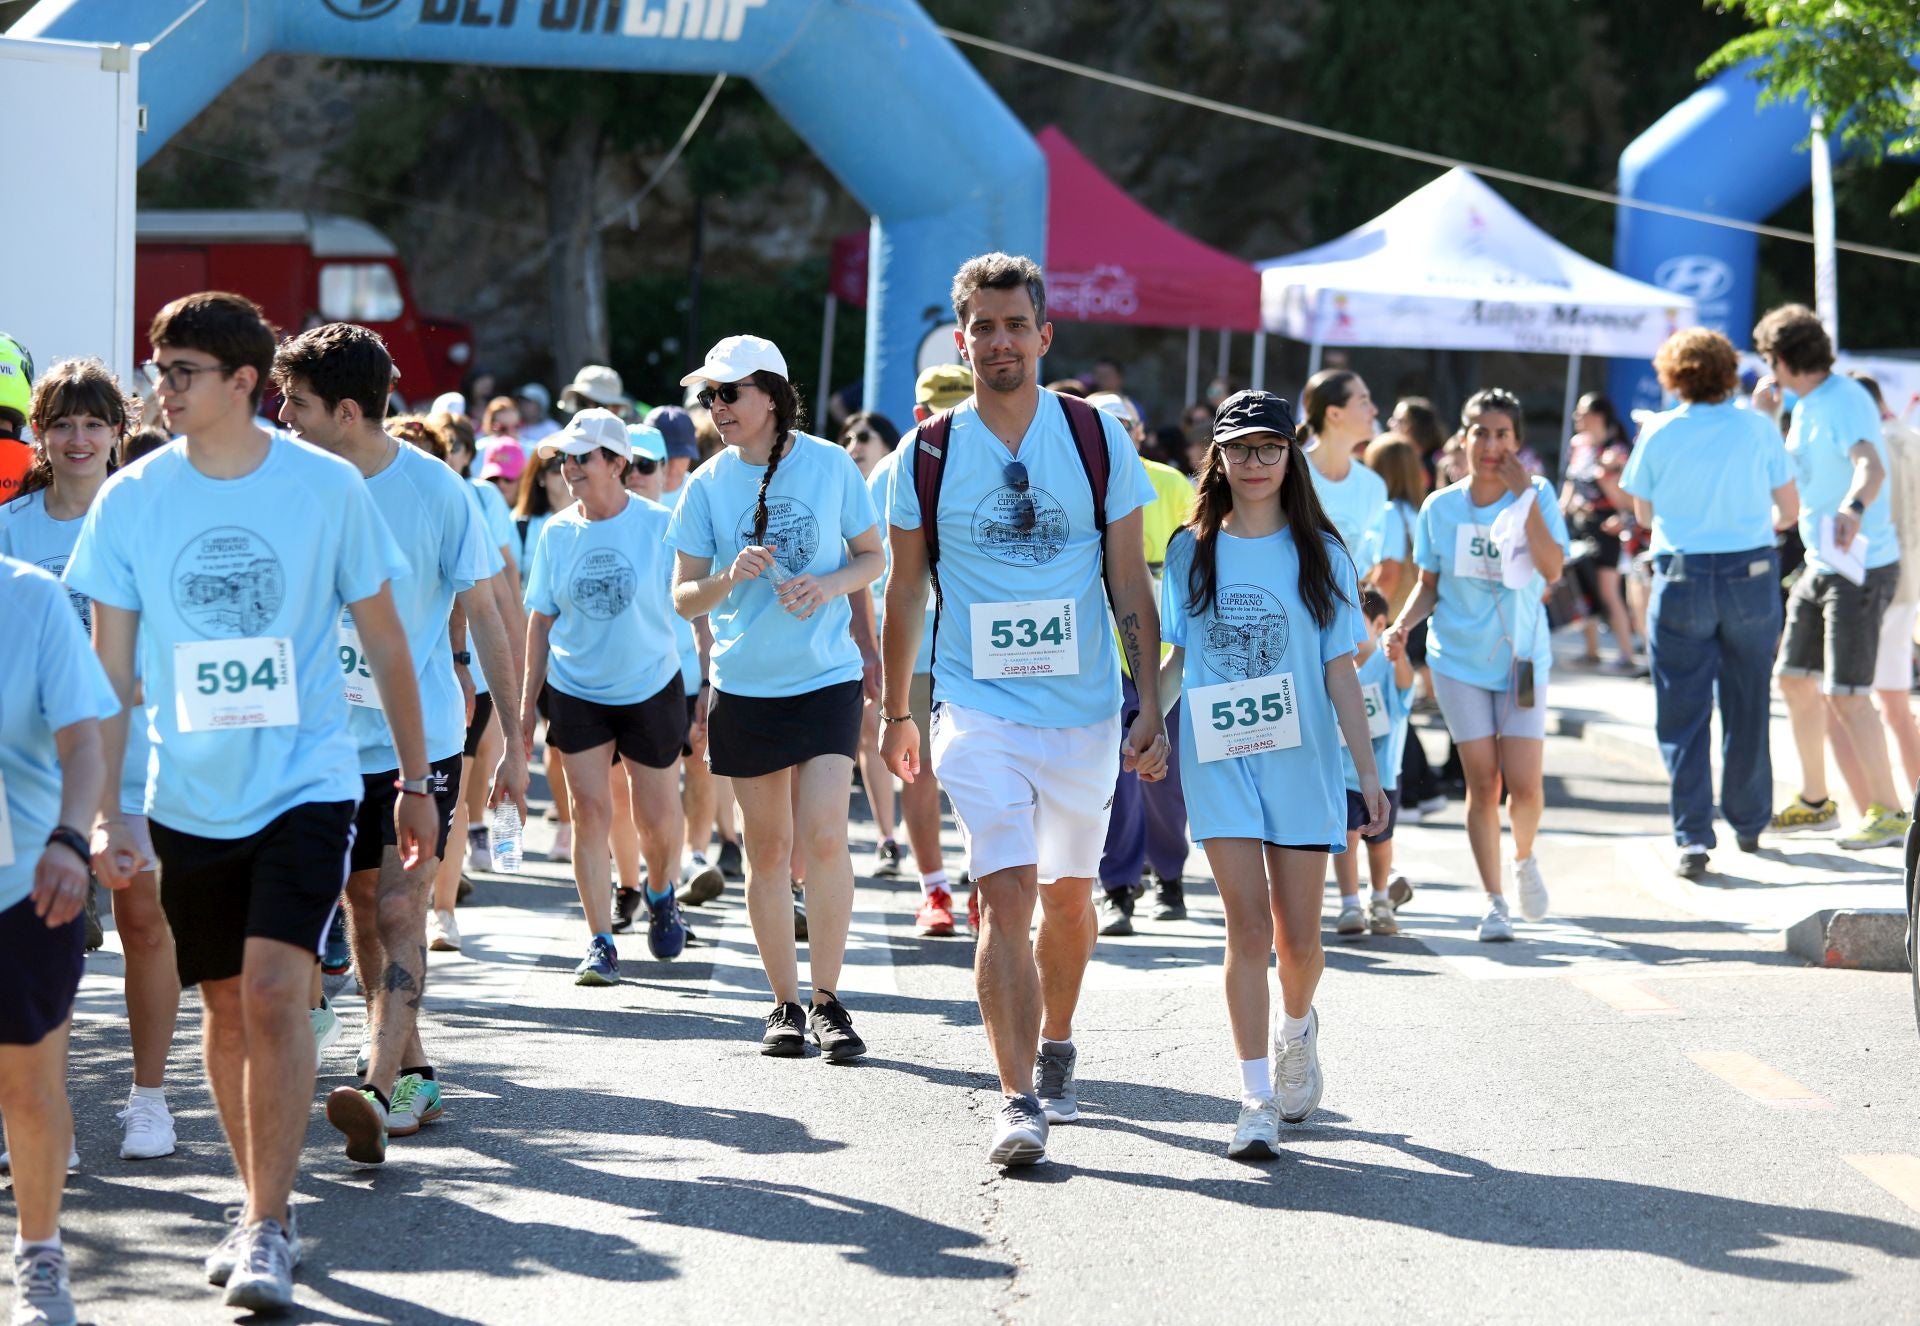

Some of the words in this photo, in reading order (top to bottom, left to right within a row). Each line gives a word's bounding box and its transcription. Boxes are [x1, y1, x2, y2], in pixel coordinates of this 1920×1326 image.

[1220, 598, 1263, 606] CIPRIANO
[990, 616, 1064, 649] 534
[1064, 604, 1072, 640] MARCHA
[197, 657, 278, 695] 594
[279, 642, 288, 685] MARCHA
[1004, 664, 1051, 672] CIPRIANO
[1212, 692, 1284, 731] 535
[1281, 678, 1292, 715] MARCHA
[1228, 739, 1274, 753] CIPRIANO
